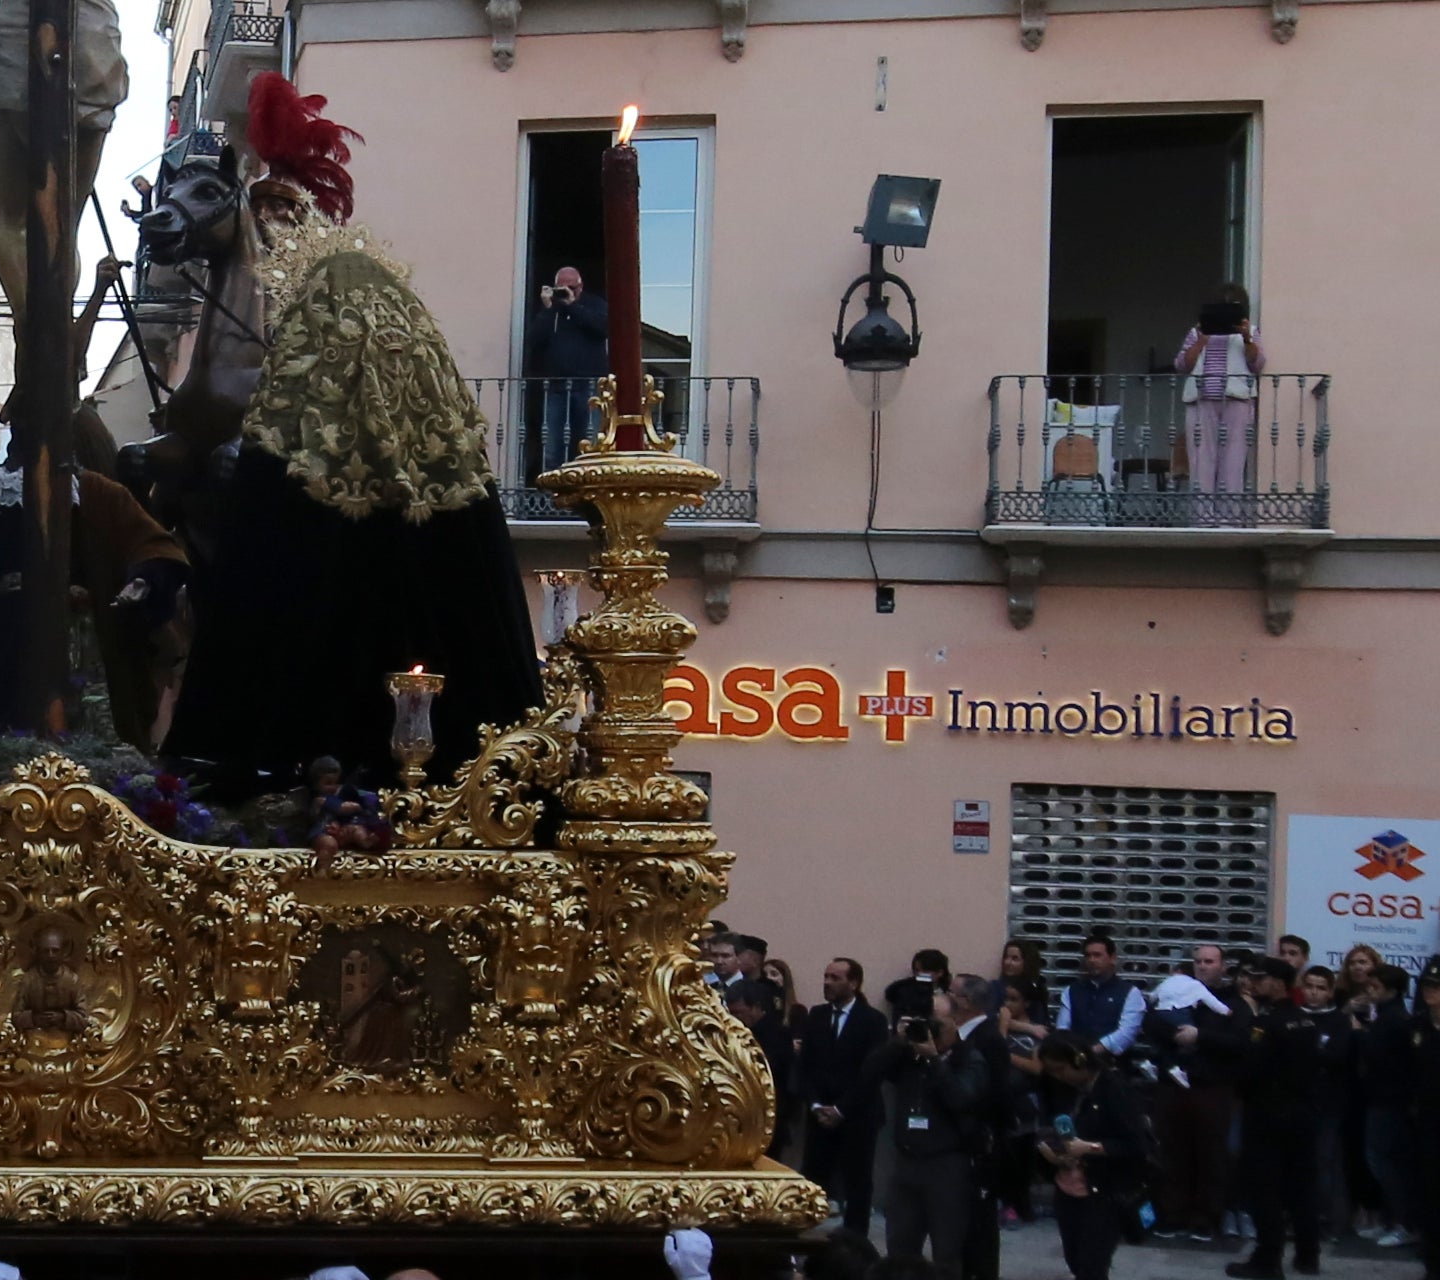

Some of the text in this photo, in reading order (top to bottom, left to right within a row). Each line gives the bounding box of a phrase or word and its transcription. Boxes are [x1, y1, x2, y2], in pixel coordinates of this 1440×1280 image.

[662, 664, 1298, 740] asa PLUS Inmobiliaria
[1327, 891, 1425, 920] casa
